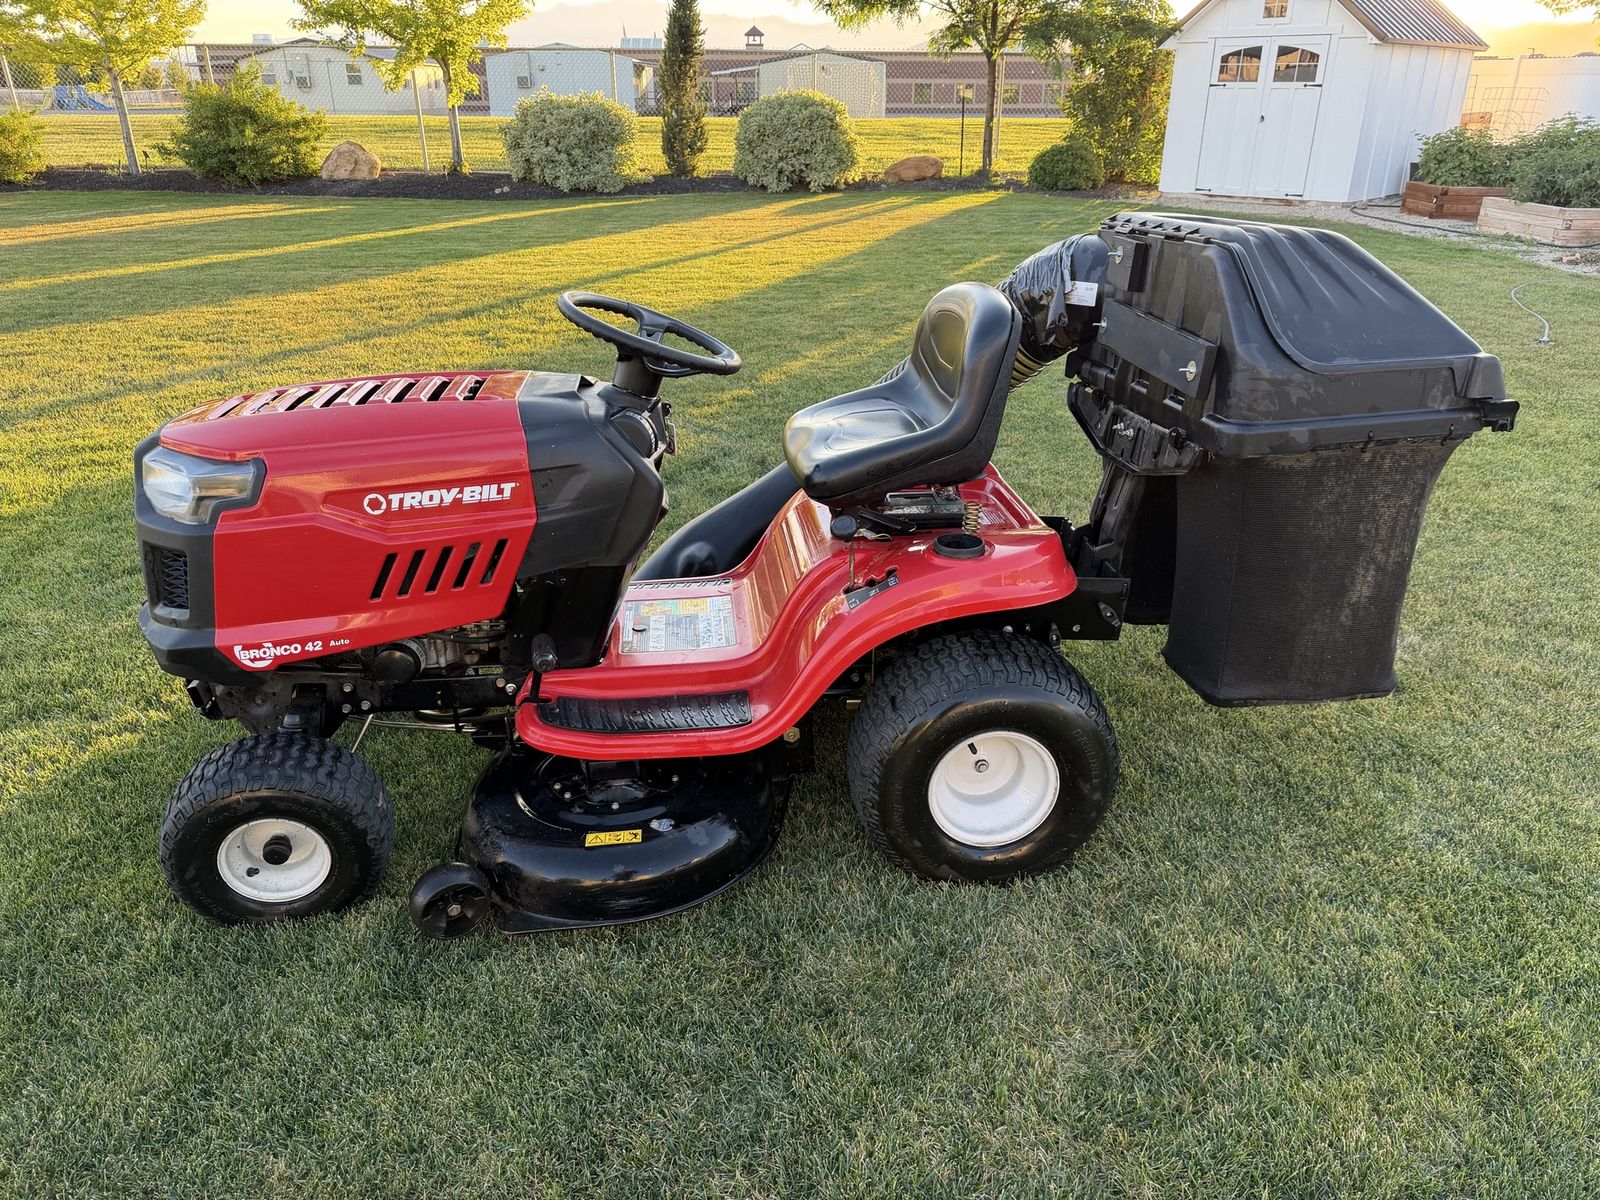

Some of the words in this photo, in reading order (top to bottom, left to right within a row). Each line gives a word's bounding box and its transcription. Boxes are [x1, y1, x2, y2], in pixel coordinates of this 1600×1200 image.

[388, 482, 516, 510] TROY-BILT
[240, 643, 302, 660] BRONCO
[304, 641, 323, 651] 42
[329, 638, 350, 646] Auto
